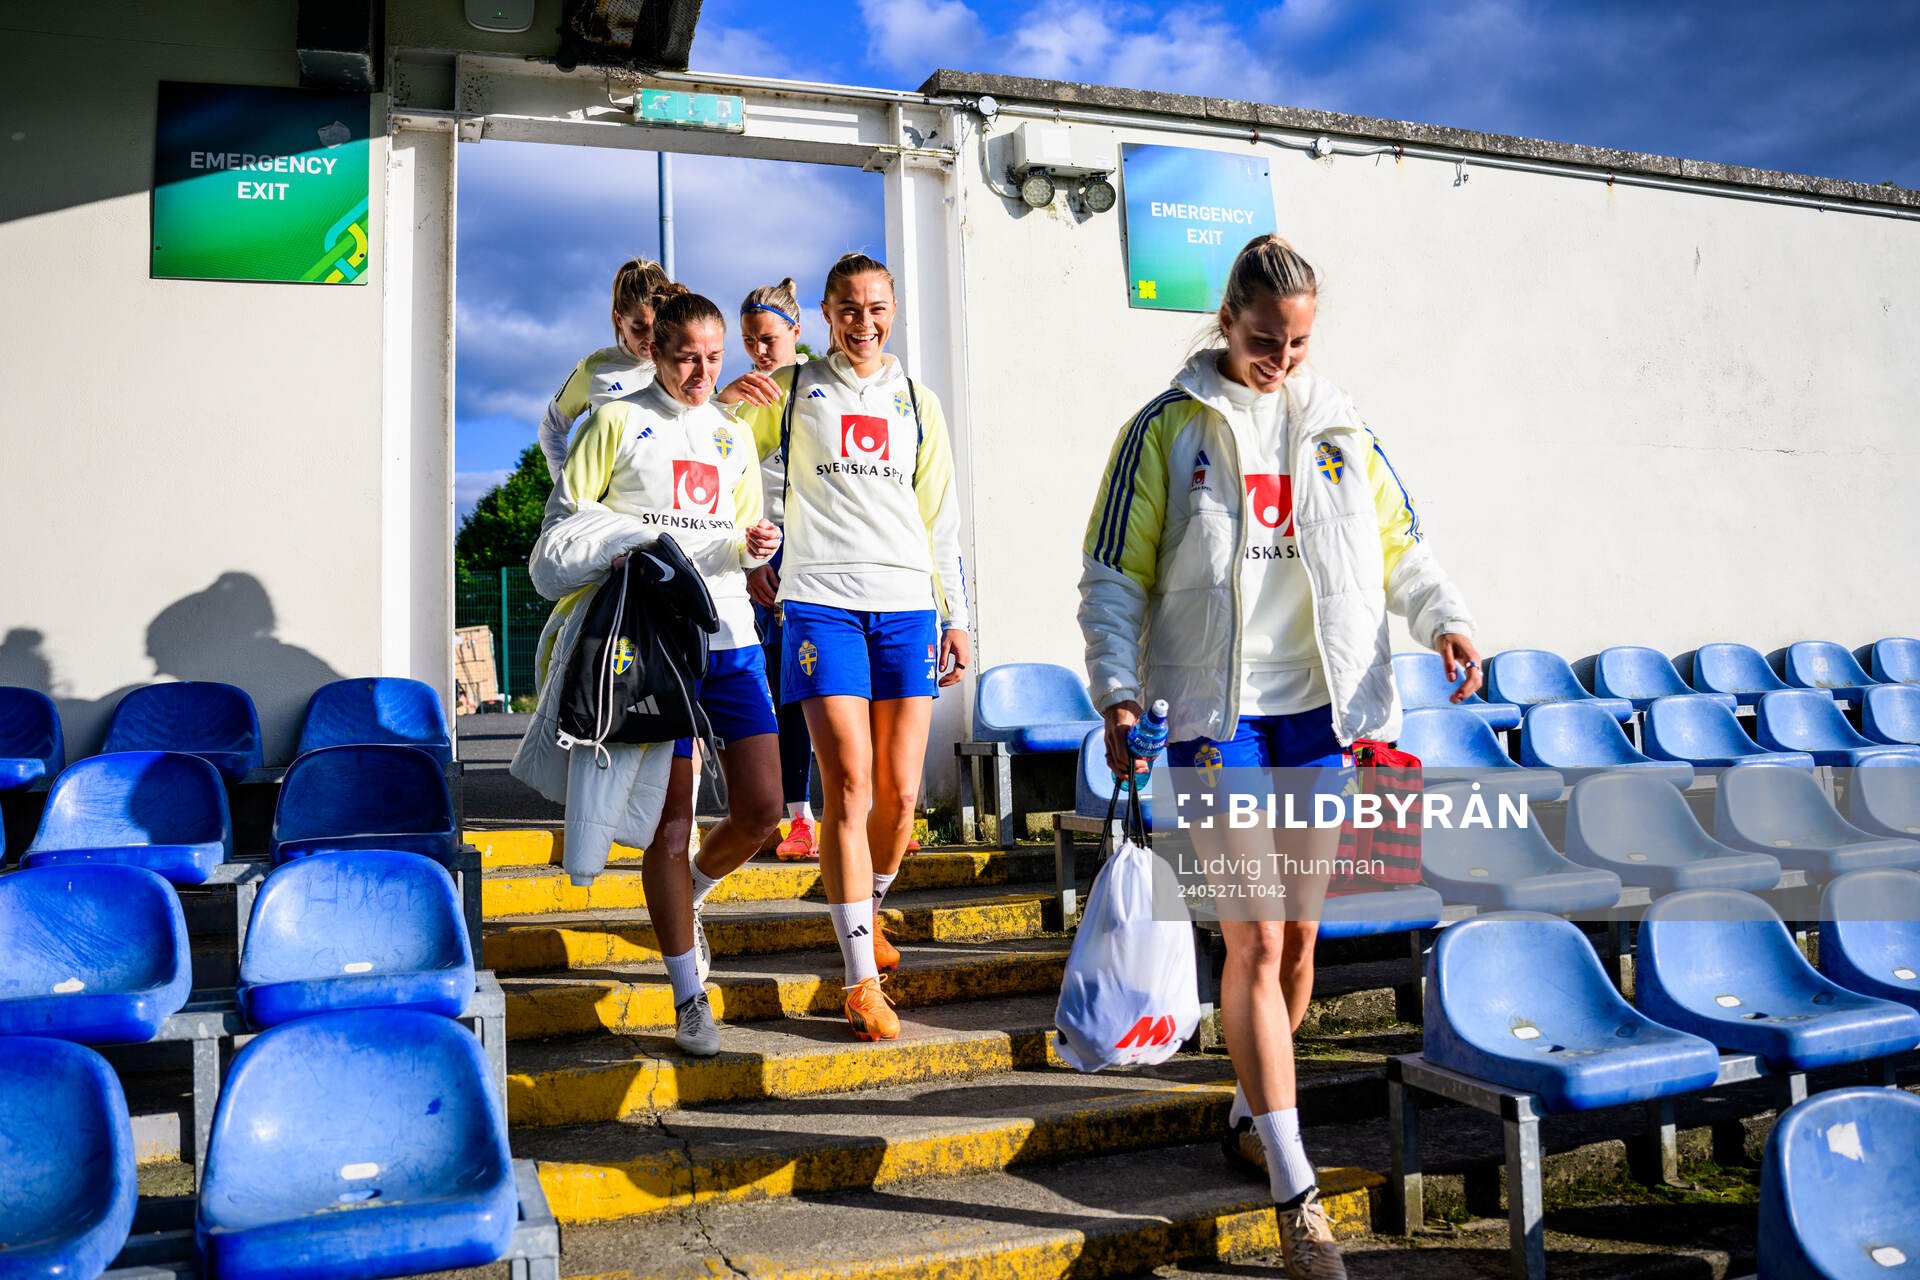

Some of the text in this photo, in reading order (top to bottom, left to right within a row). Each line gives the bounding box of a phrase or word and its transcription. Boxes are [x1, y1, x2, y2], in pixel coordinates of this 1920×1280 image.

[190, 151, 338, 175] EMERGENCY
[237, 181, 290, 201] EXIT
[1151, 201, 1254, 225] EMERGENCY
[1187, 228, 1224, 245] EXIT
[816, 462, 879, 476] SVENSKA
[642, 513, 707, 530] SVENSKA
